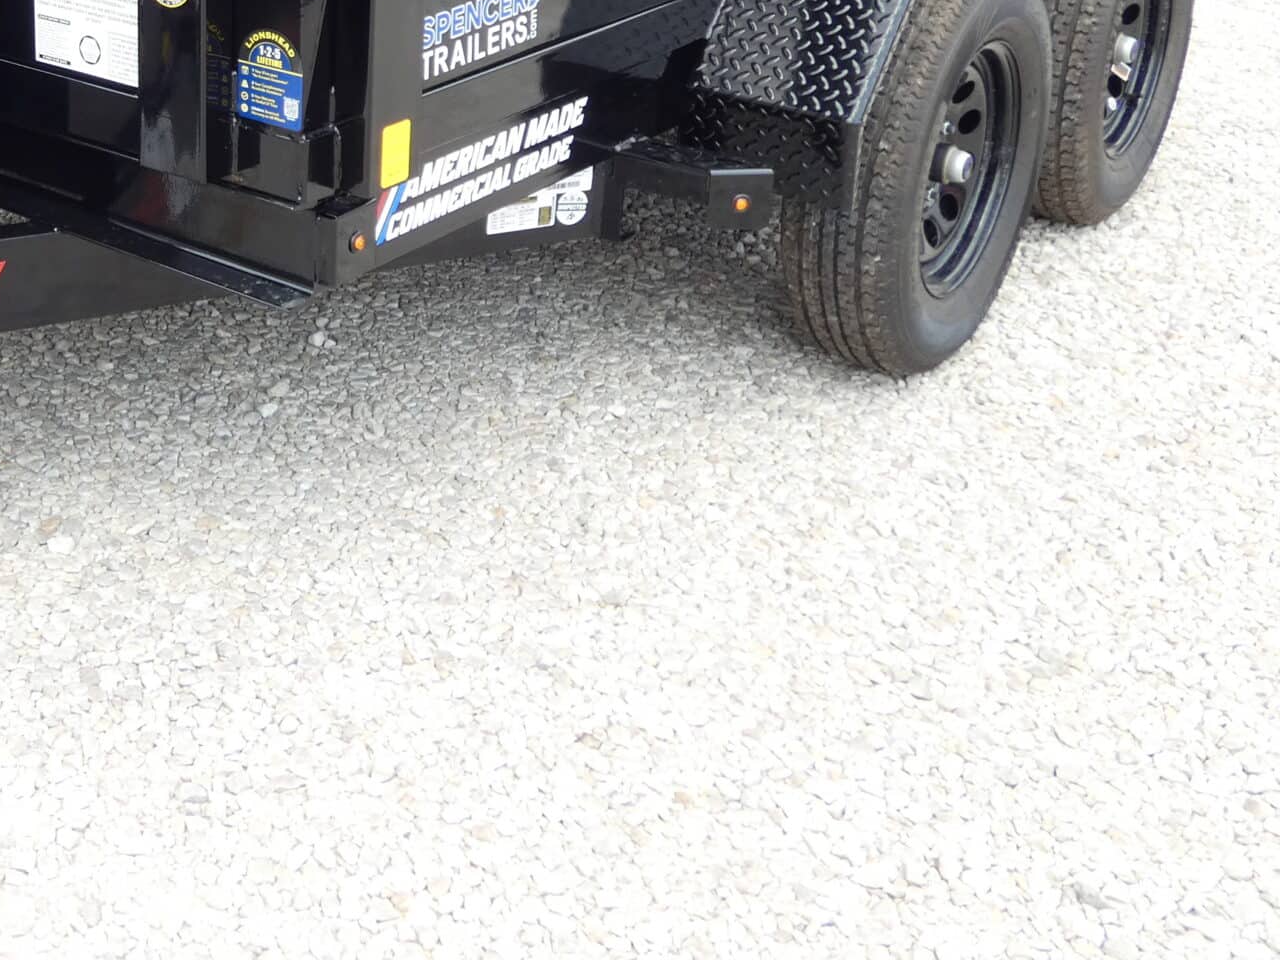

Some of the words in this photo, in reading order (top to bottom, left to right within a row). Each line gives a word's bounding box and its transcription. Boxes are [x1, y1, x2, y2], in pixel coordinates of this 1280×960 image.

[422, 14, 528, 80] TRAILERS
[385, 163, 512, 242] COMMERCIAL
[511, 134, 575, 184] GRADE
[400, 122, 527, 203] AMERICAN
[523, 96, 589, 149] MADE
